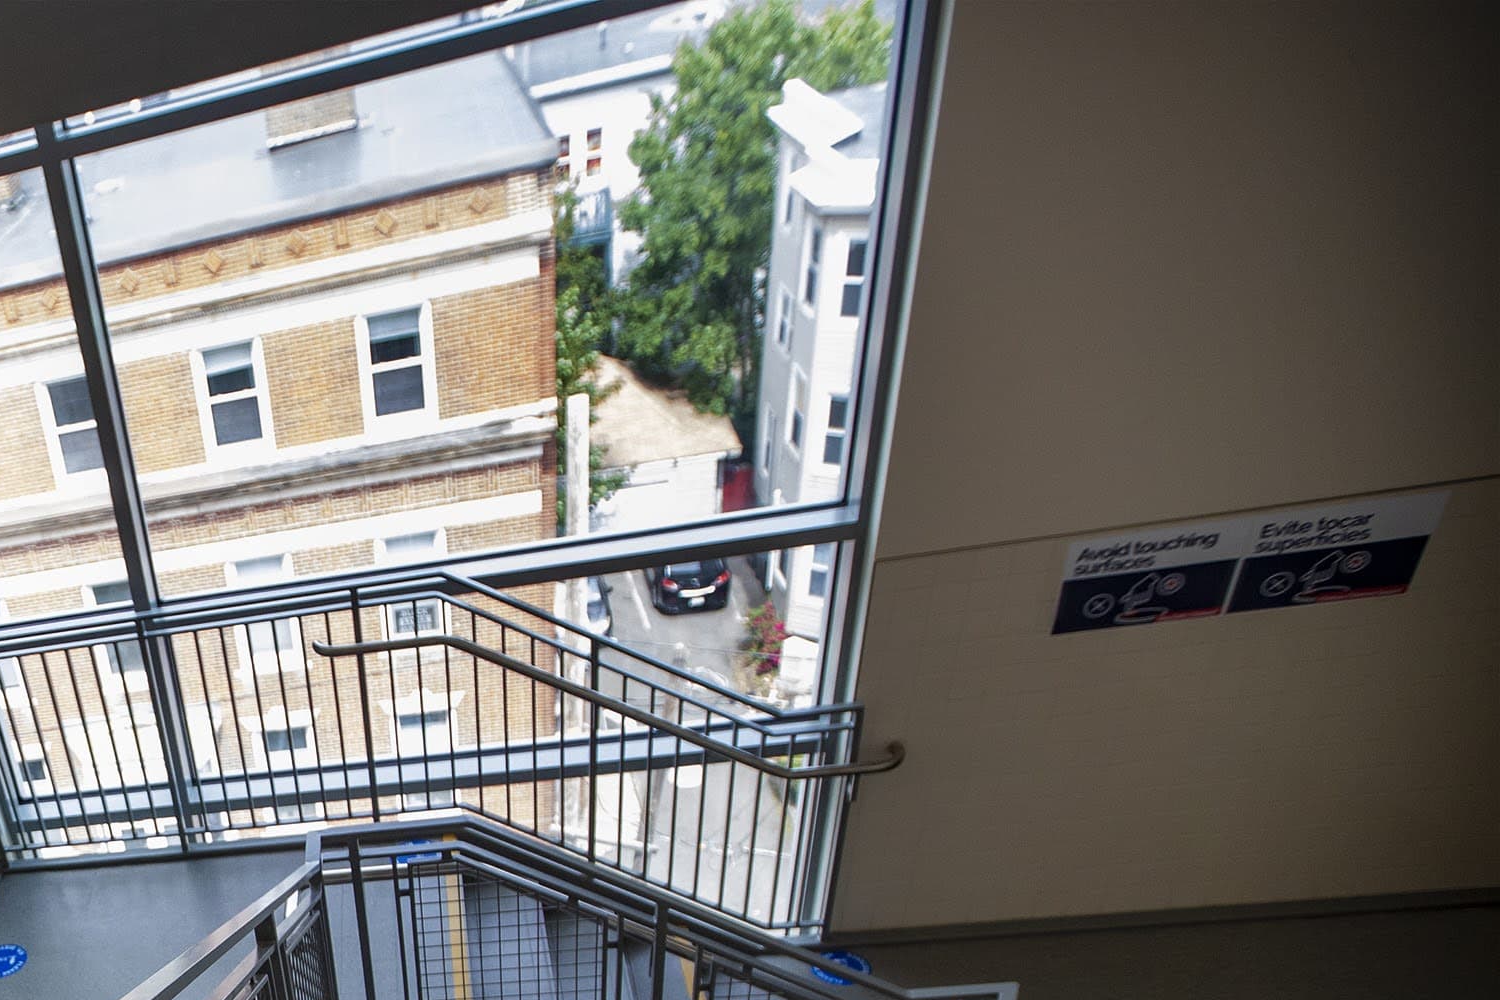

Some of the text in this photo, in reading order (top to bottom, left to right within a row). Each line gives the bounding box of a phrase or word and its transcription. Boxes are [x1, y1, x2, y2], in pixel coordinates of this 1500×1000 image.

[1259, 511, 1375, 538] Evite tocar
[1075, 532, 1221, 562] Avoid touching
[1253, 527, 1371, 555] superficies
[1074, 555, 1155, 575] surfaces
